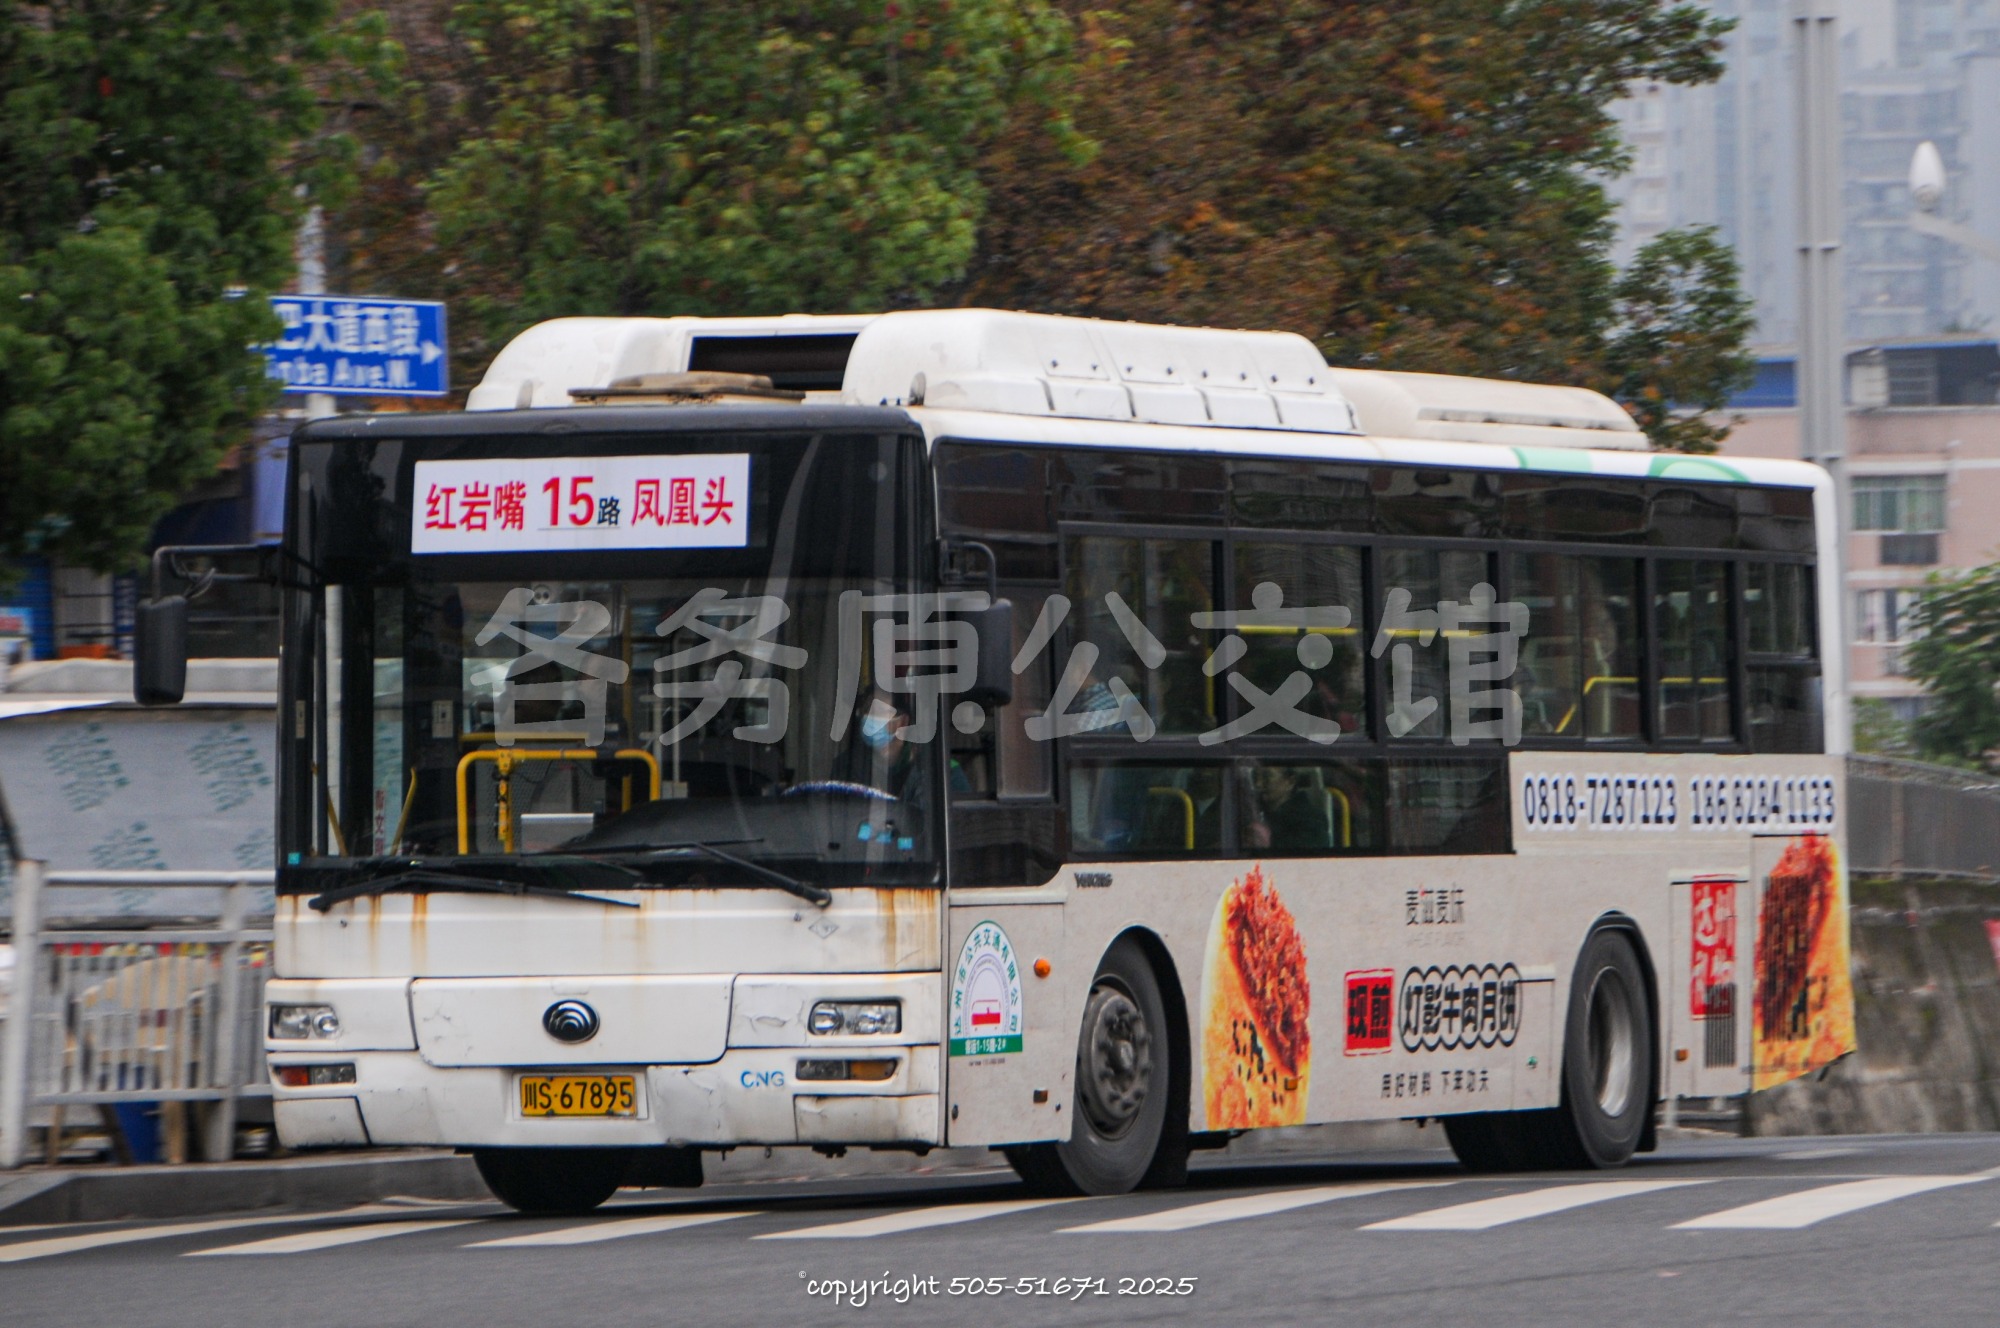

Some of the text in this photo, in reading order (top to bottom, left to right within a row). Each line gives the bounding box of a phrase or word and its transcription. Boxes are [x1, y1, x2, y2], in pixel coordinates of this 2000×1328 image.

[424, 481, 527, 532] 红岩嘴
[631, 476, 734, 527] 凤凰头
[1524, 777, 1677, 825] 0818-7287123
[1402, 979, 1517, 1036] 灯影牛肉月饼
[740, 1070, 785, 1088] CNG
